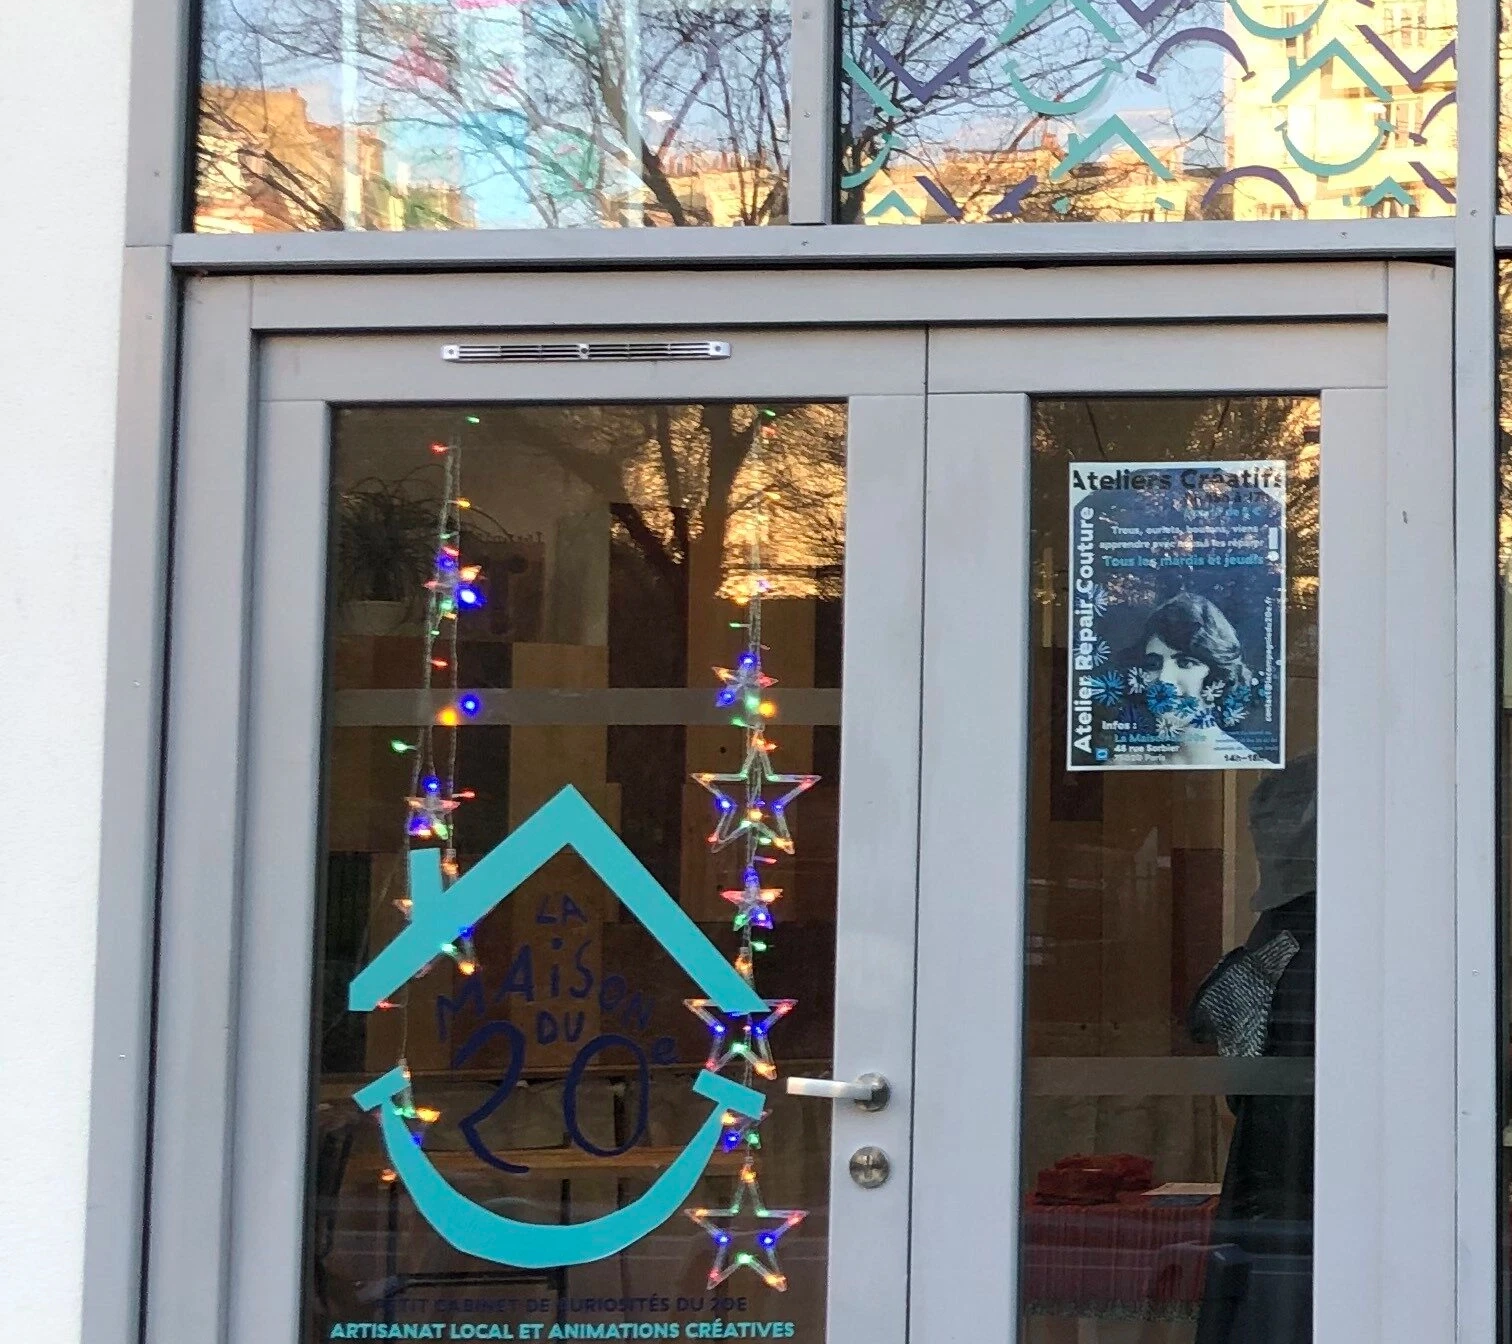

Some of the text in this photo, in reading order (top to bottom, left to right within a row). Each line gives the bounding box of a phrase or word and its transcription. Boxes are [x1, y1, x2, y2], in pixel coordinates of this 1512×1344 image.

[1073, 469, 1172, 490] Ateliers
[1101, 555, 1136, 566] Tous
[1073, 507, 1098, 754] Atelier Repair Couture
[536, 894, 588, 924] LA
[534, 1009, 586, 1045] DU
[525, 1297, 551, 1313] DE
[677, 1297, 704, 1313] DU
[330, 1316, 795, 1340] ARTISANAT LOCAL ET ANIMATIONS CRÉATIVES
